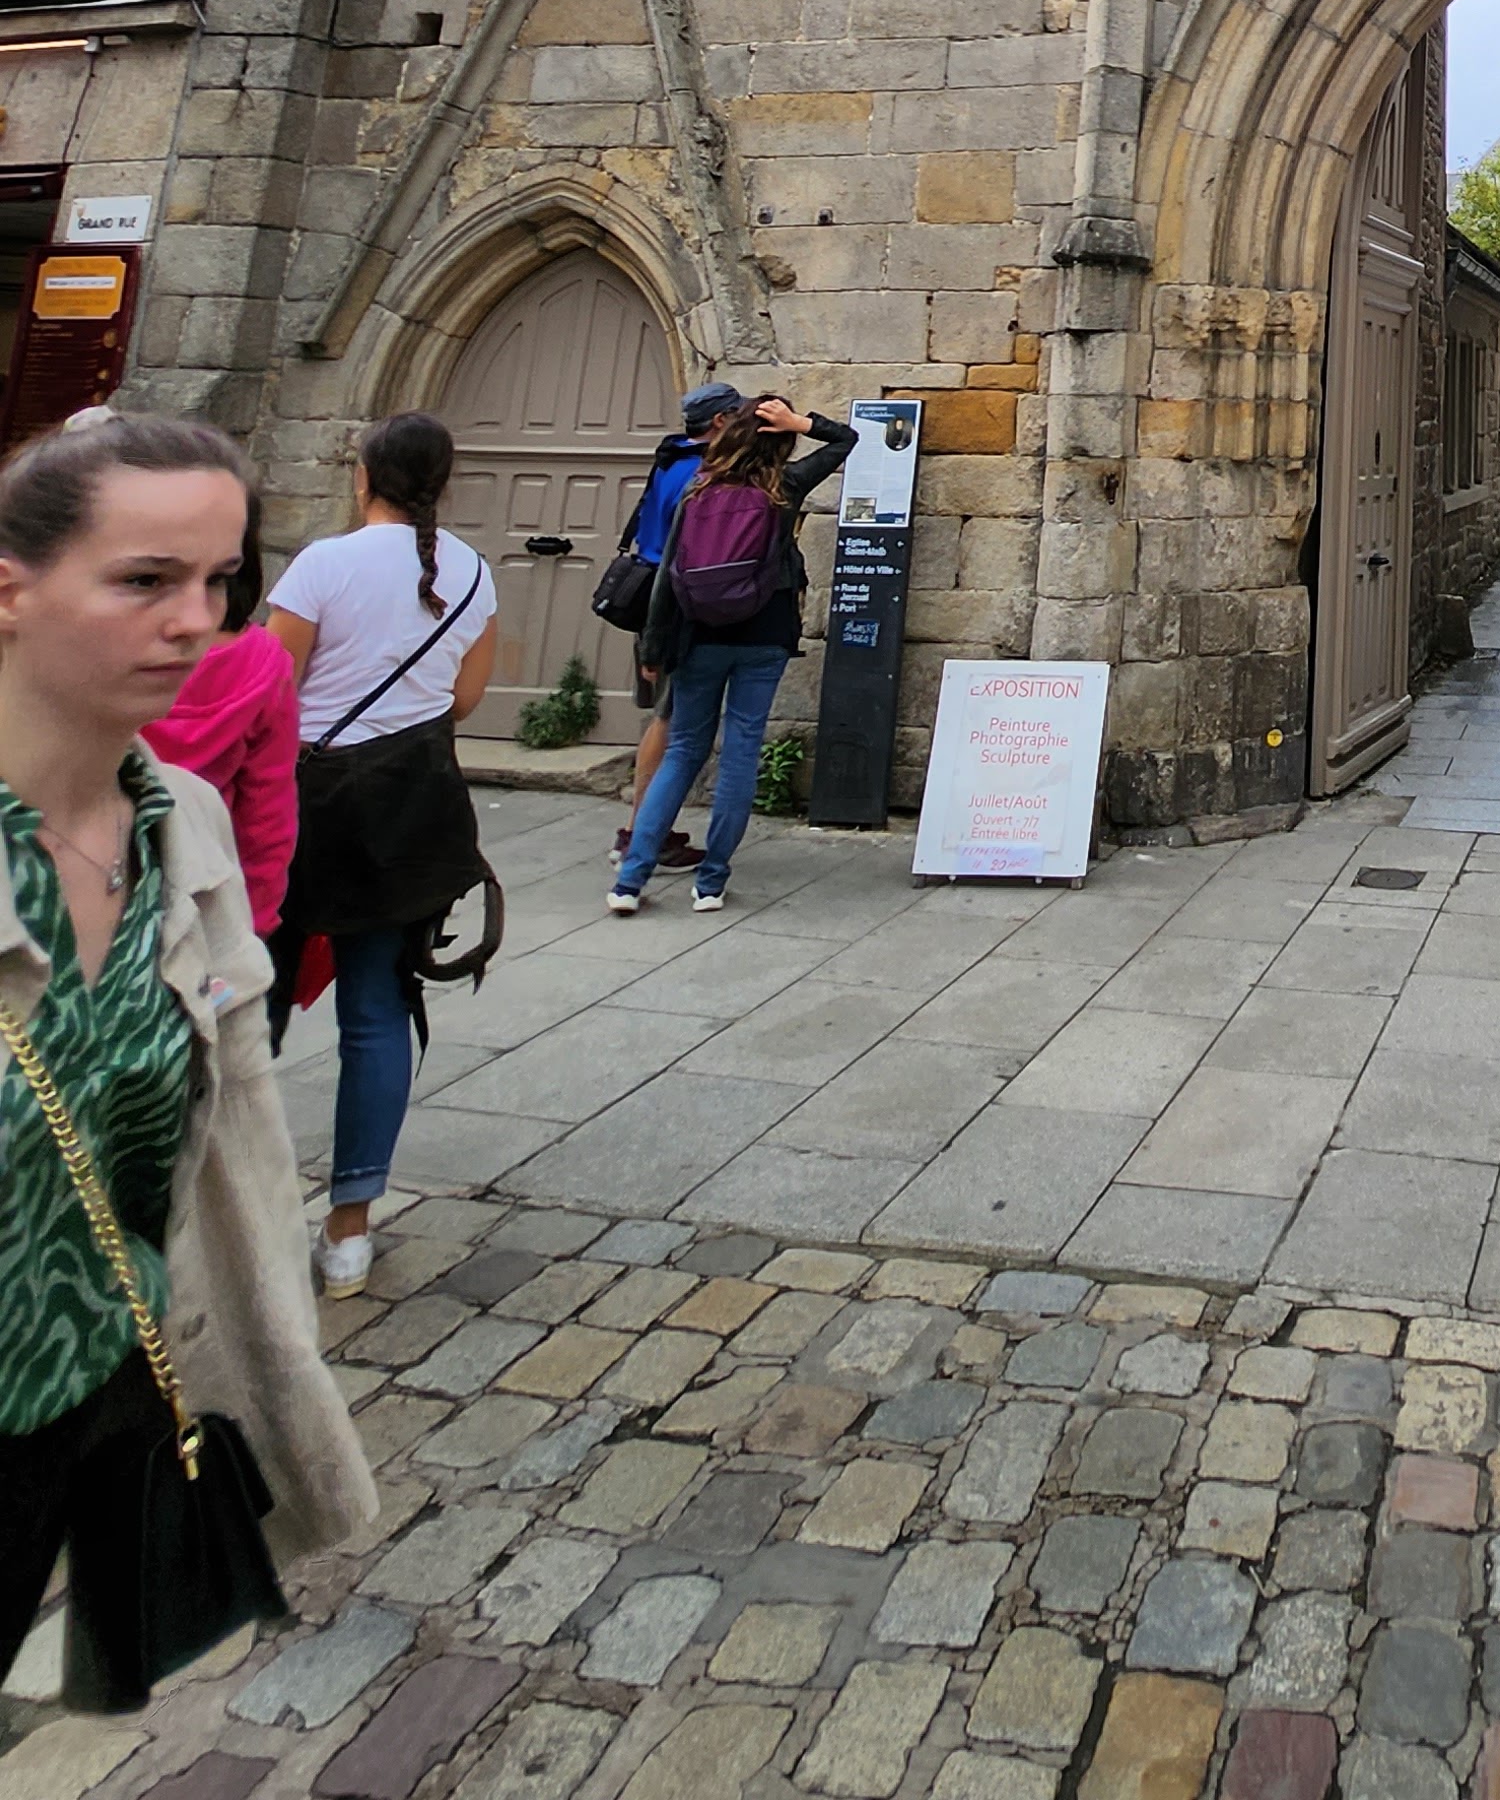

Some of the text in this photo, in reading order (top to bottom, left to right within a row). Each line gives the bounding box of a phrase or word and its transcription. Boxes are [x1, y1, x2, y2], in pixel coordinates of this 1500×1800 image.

[970, 680, 1079, 698] EXPOSITION
[990, 717, 1051, 732] Peinture
[970, 731, 1069, 750] Photographie
[981, 749, 1051, 766] Sculpture
[968, 794, 1048, 810] Juillet/Août
[973, 813, 1013, 826] Ouvert
[1023, 815, 1040, 828] 7/7
[971, 827, 1039, 840] Entrée libre
